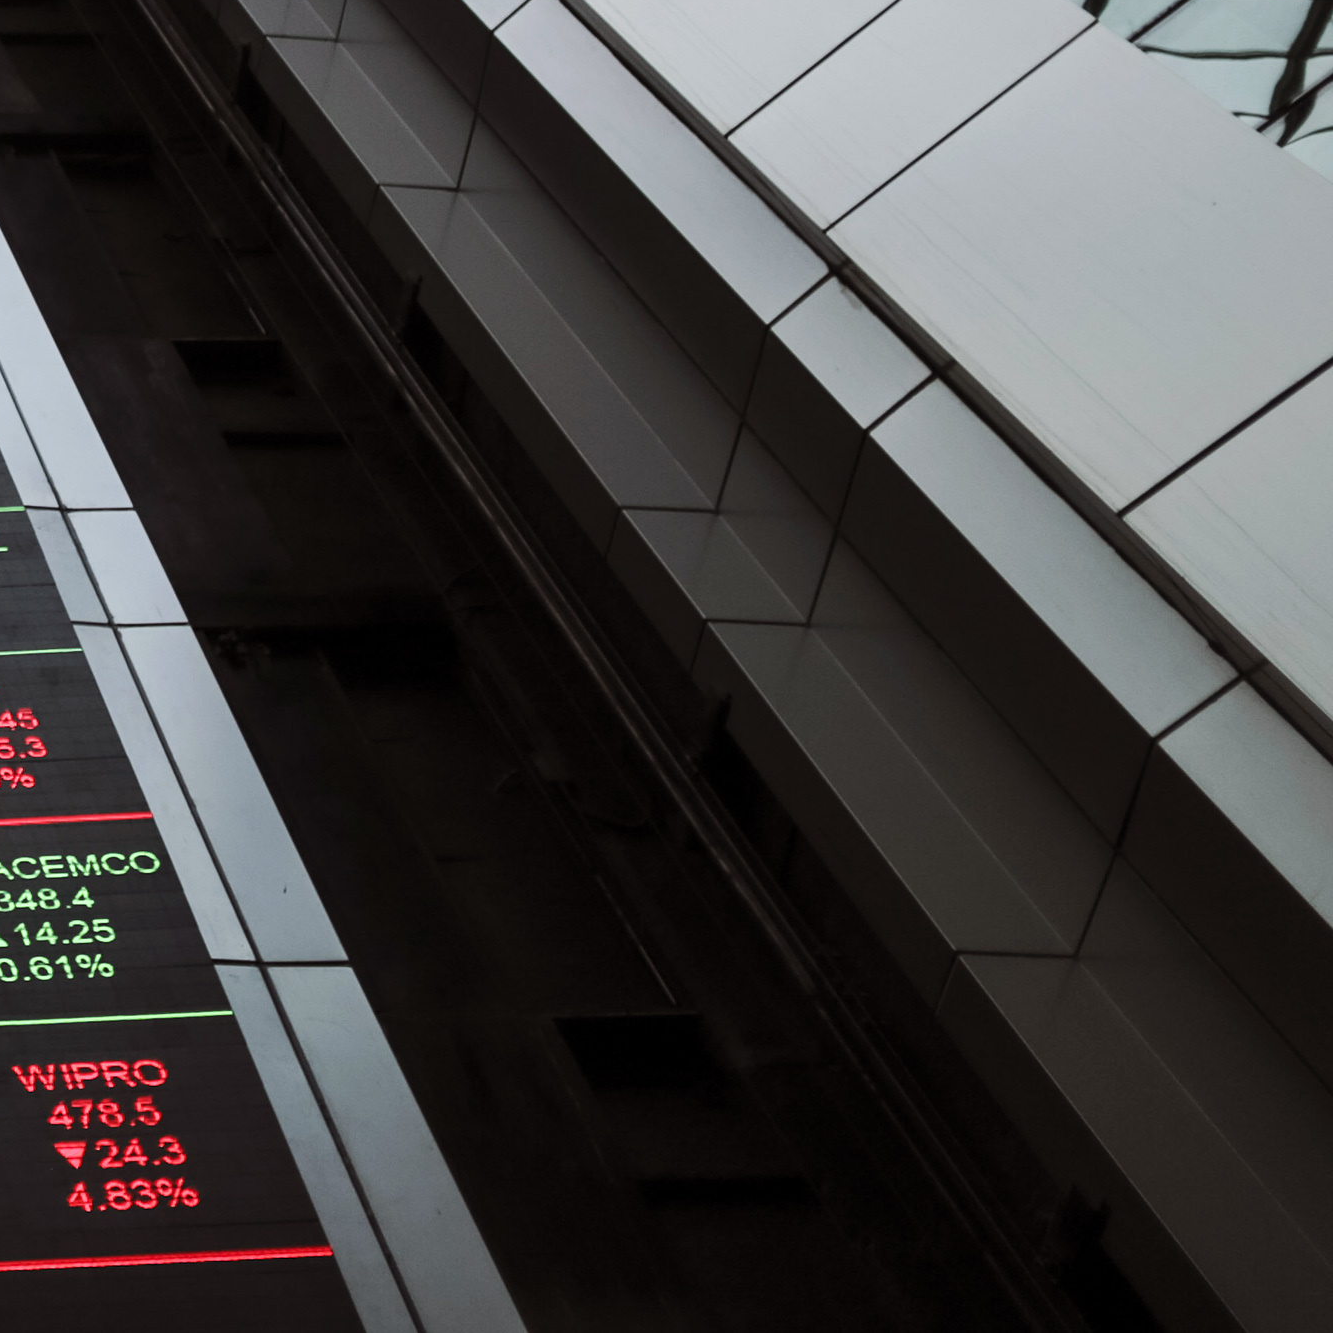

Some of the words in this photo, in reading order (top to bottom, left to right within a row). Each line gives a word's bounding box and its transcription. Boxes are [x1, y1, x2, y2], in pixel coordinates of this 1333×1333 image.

[14, 919, 115, 945] 14.25
[12, 1060, 168, 1092] WIPRO
[48, 1096, 162, 1129] 478.5
[95, 1136, 186, 1168] 24.3
[67, 1178, 199, 1212] 4.83%
